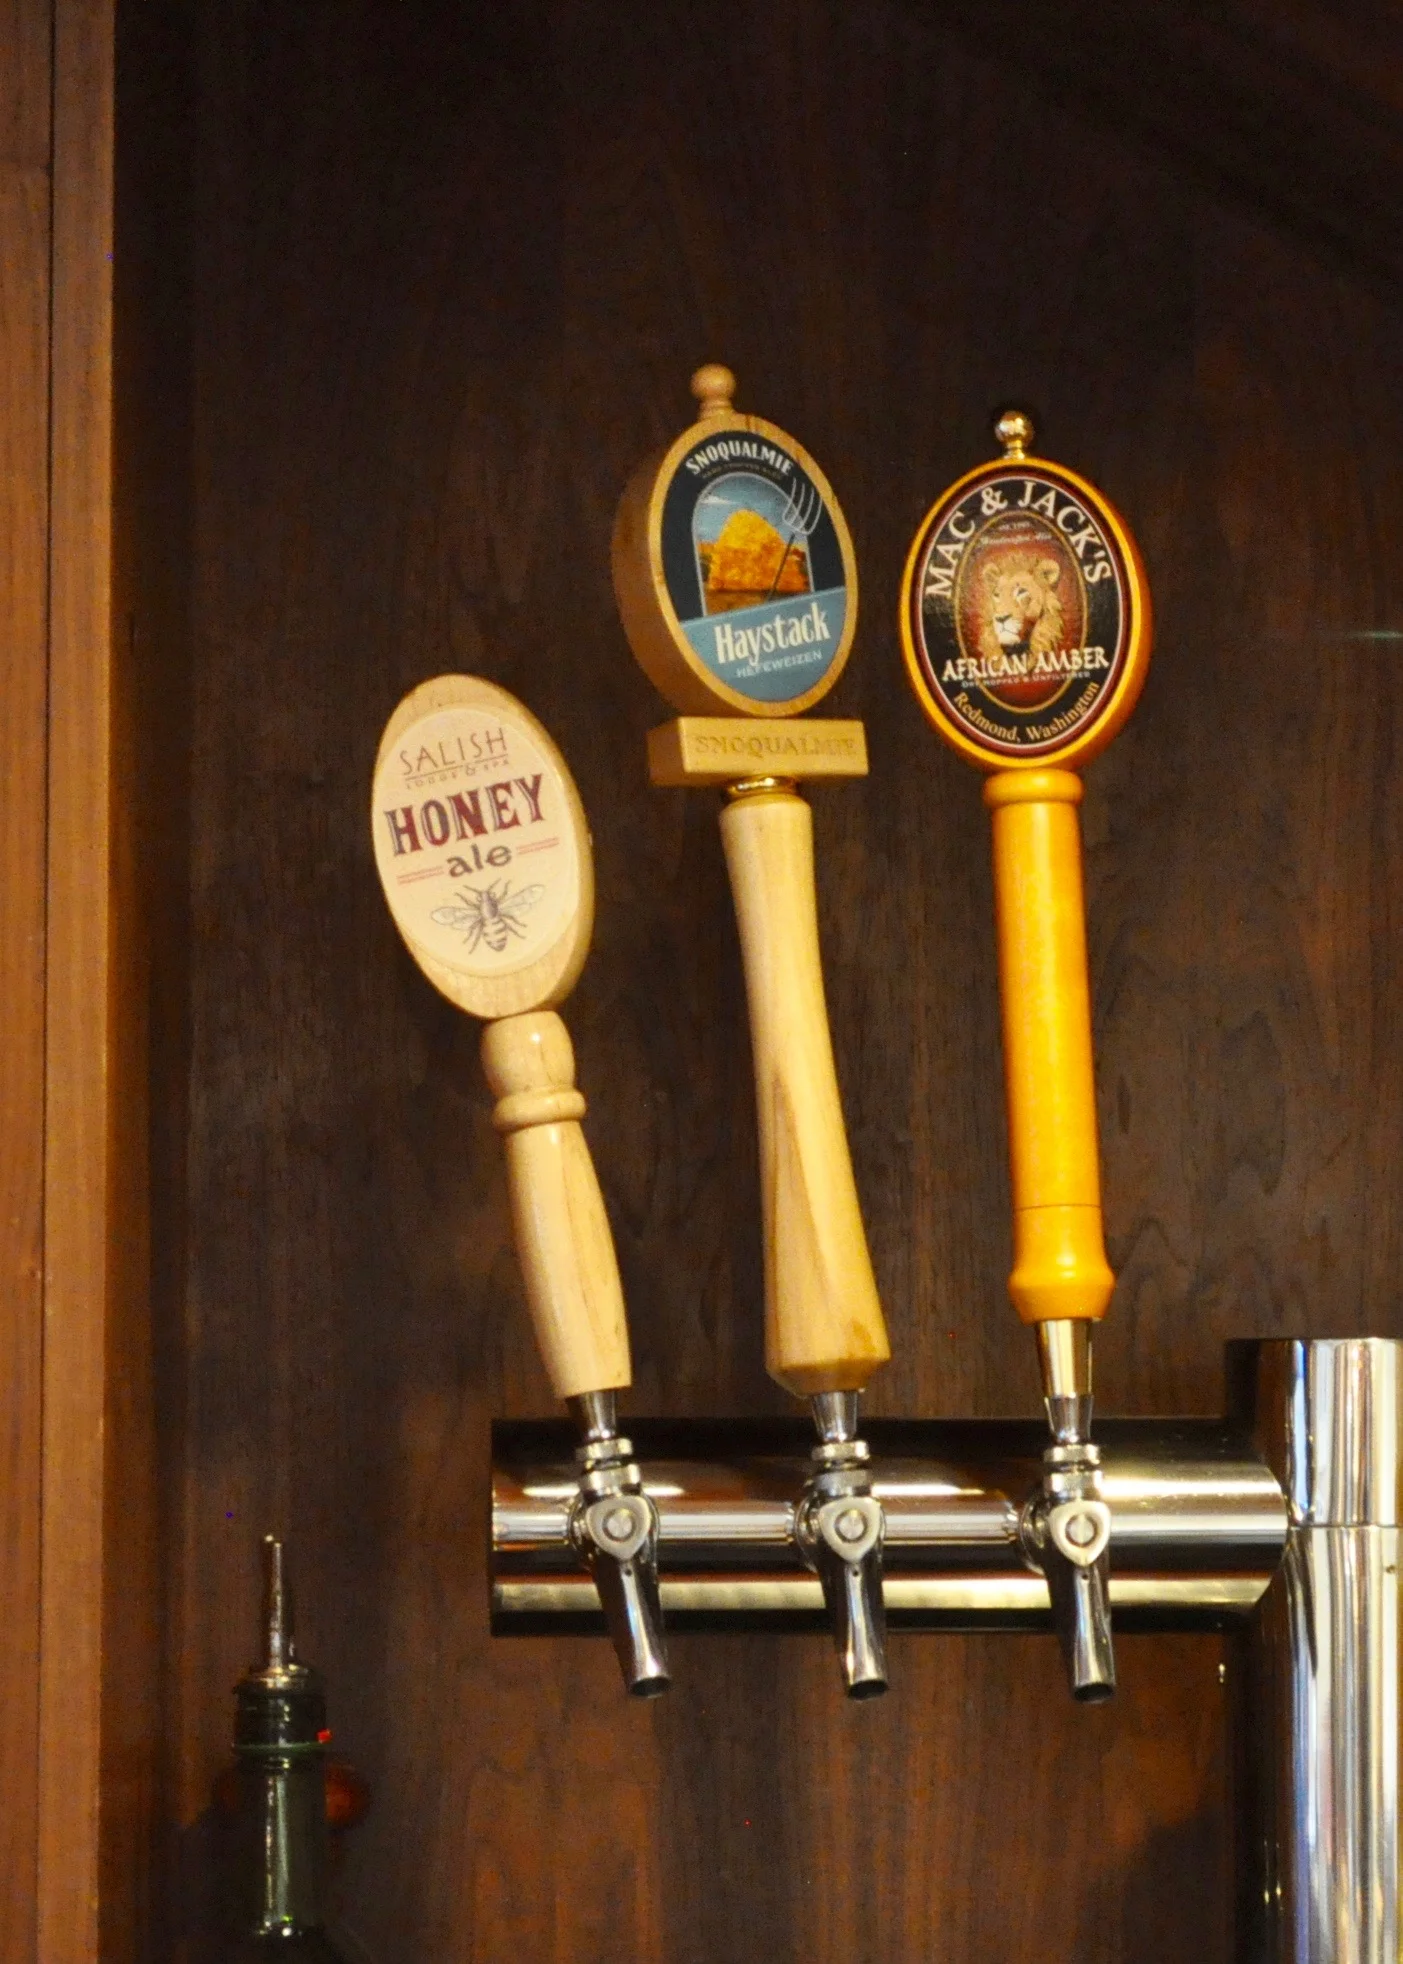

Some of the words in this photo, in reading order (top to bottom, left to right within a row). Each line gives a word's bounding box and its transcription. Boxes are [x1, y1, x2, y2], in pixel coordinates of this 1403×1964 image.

[685, 440, 794, 476] SNOQUALMIE
[925, 511, 977, 600] MAC
[980, 486, 1009, 517] &
[1017, 480, 1113, 585] JACK'S
[714, 601, 831, 667] Haystack
[942, 653, 1028, 682] AFRICAN
[1034, 646, 1110, 672] AMBER
[953, 690, 1022, 744] Redmond,
[1025, 681, 1101, 741] Washington
[399, 727, 508, 776] SALISH
[383, 773, 546, 857] HONEY
[446, 843, 513, 878] ale
